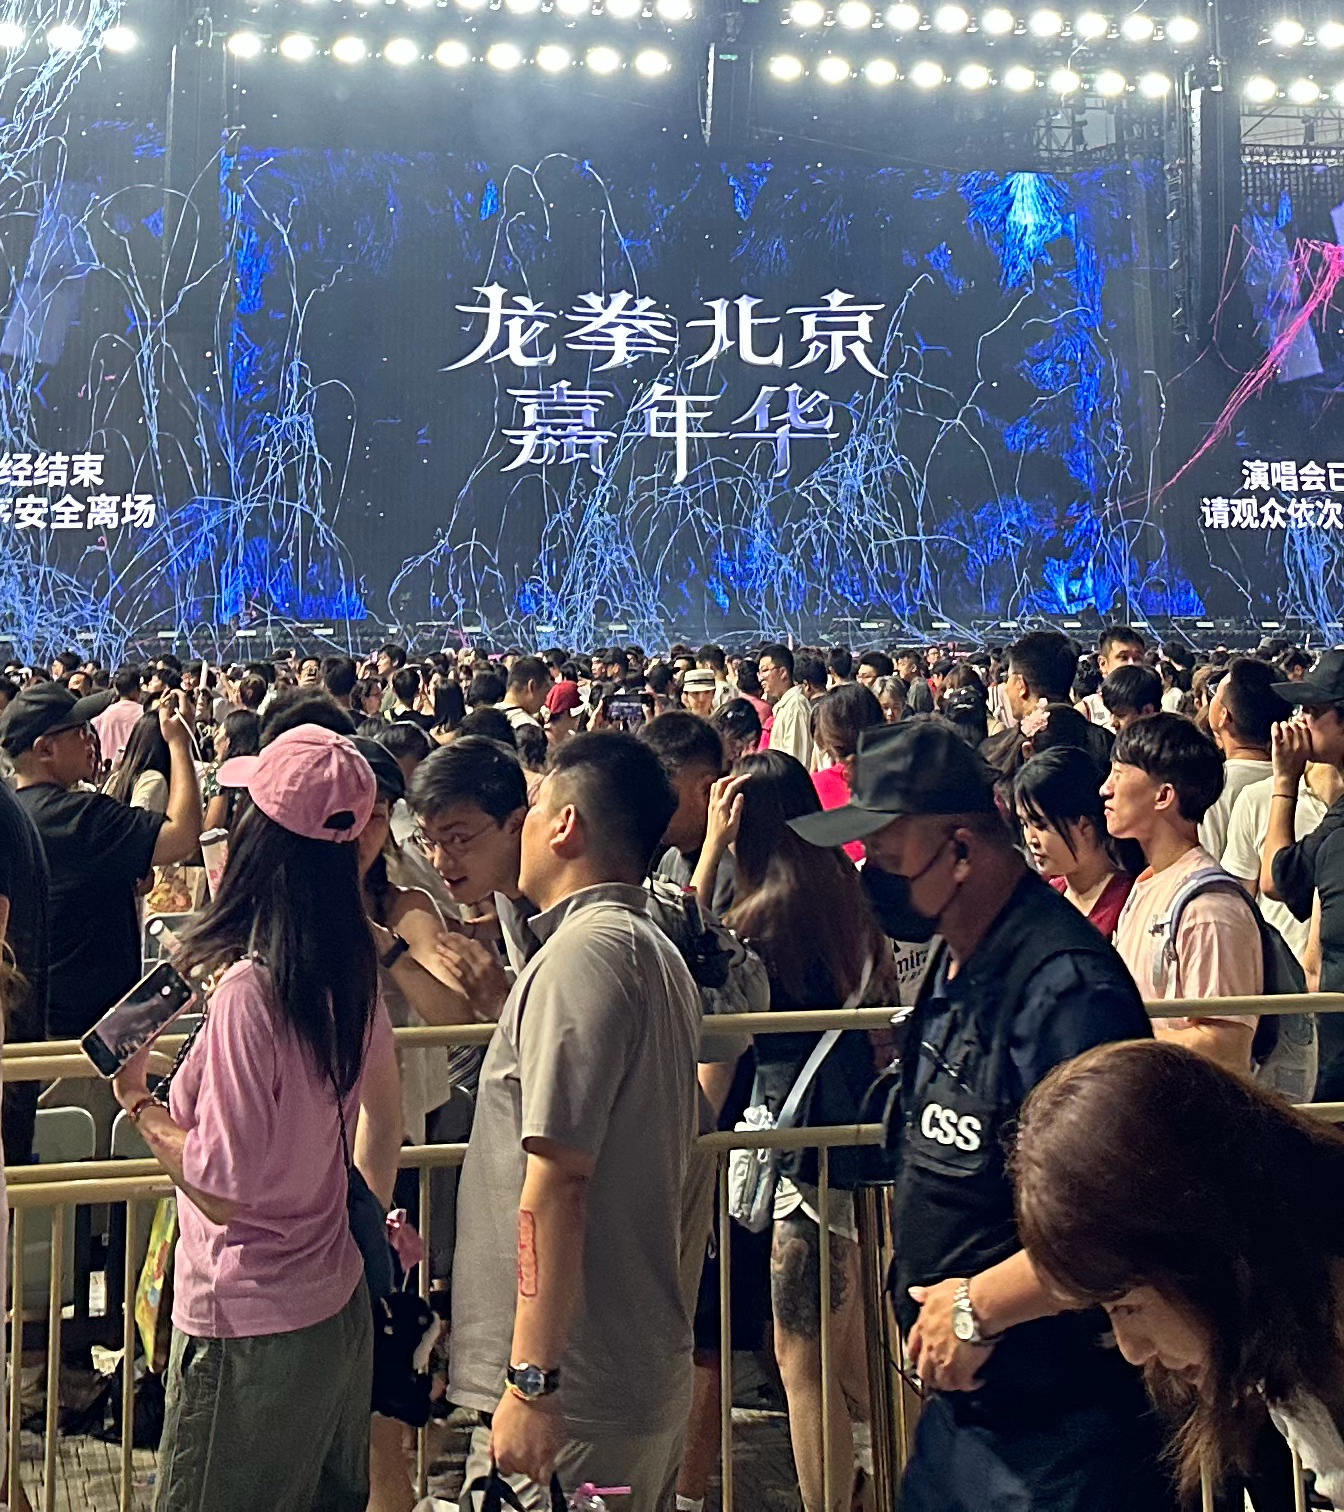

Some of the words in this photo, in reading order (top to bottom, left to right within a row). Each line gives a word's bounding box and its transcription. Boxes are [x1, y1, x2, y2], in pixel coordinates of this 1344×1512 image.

[438, 281, 888, 379] 龙拳北京
[500, 379, 840, 483] 嘉年华
[921, 1103, 982, 1152] CSS
